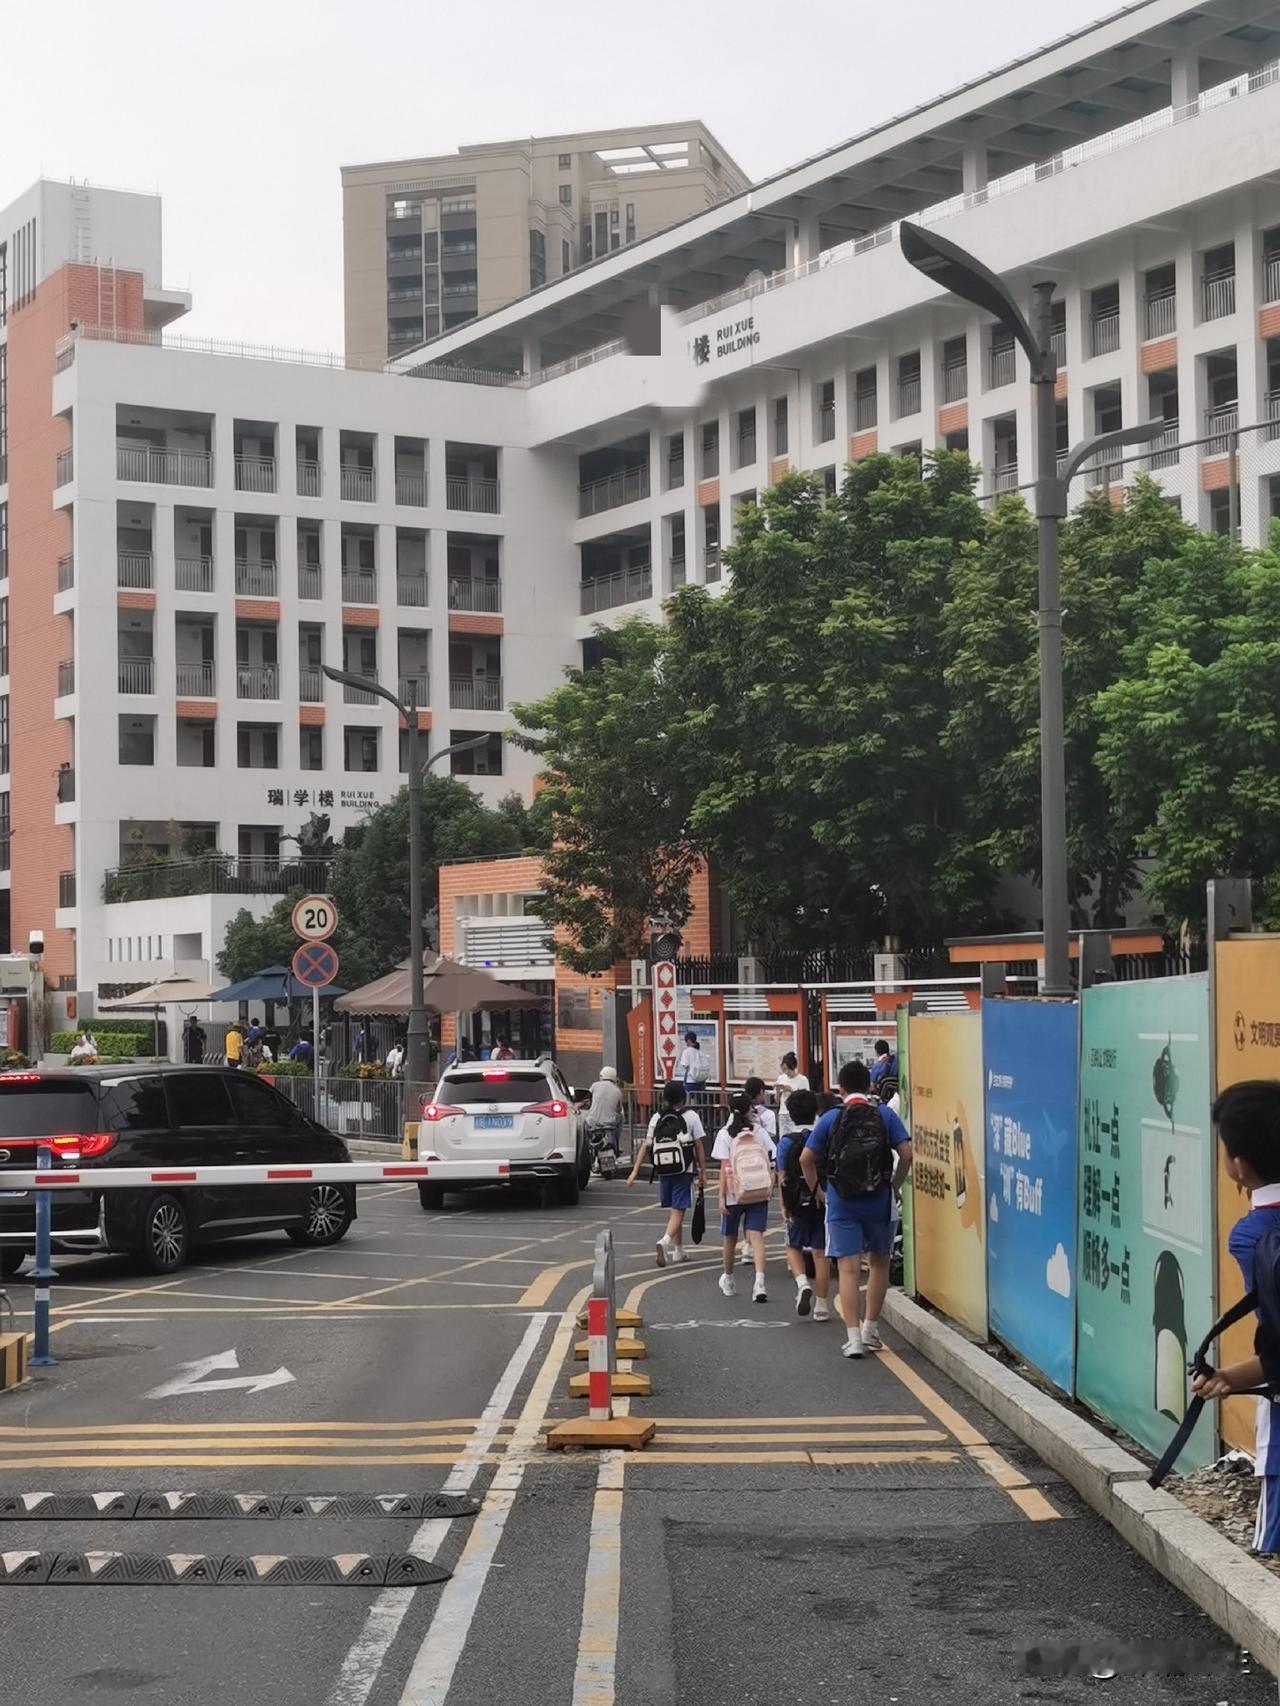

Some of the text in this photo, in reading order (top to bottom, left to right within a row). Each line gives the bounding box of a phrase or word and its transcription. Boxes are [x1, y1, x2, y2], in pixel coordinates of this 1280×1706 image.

[717, 316, 754, 342] RUI XUE
[717, 332, 760, 358] BUILDING
[340, 790, 374, 799] RUI XUE
[340, 800, 380, 808] BUILDING
[305, 908, 328, 929] 20
